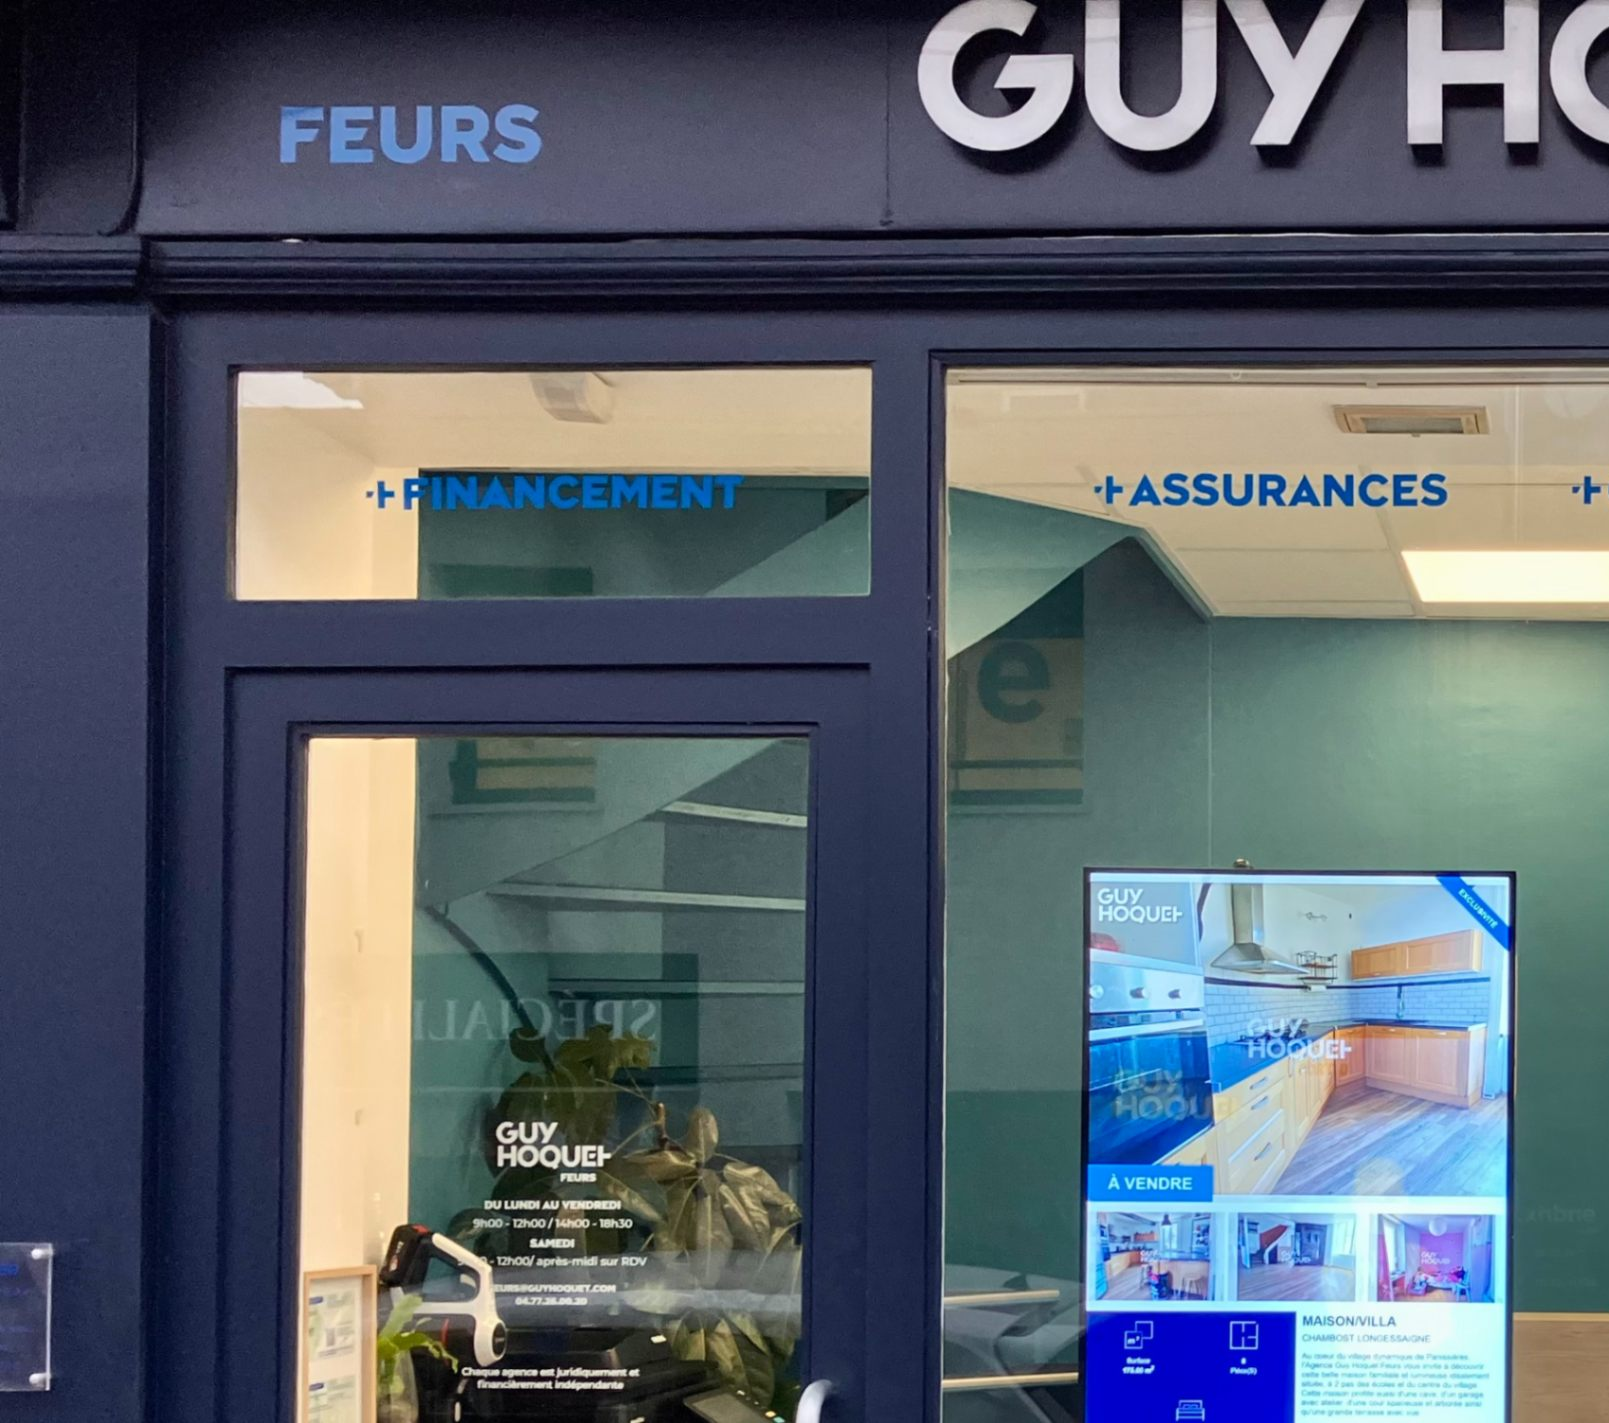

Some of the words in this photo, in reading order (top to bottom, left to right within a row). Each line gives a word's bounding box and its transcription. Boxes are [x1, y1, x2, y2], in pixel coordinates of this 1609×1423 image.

[916, 0, 1365, 152] GUY
[278, 104, 543, 165] FEURS
[1097, 888, 1144, 904] GUY
[1246, 1018, 1305, 1040] GUY
[495, 1121, 559, 1145] GUY
[560, 1173, 597, 1183] FEURS
[1107, 1174, 1120, 1191] À
[1125, 1177, 1193, 1191] VENDRE
[484, 1200, 502, 1210] DU
[504, 1200, 540, 1210] LUNDI
[542, 1200, 559, 1210] AU
[561, 1200, 622, 1210] VENDREDI
[472, 1218, 503, 1229] 9h00
[513, 1218, 546, 1229] 12h00
[555, 1218, 590, 1229] 14h00
[600, 1218, 633, 1229] 18h30
[529, 1238, 575, 1248] SAMEDI
[536, 1256, 598, 1268] après-midi
[600, 1258, 618, 1266] sur
[622, 1256, 648, 1267] RDV
[494, 1284, 617, 1293] EURS@GUYHOQUET.COM
[1302, 1315, 1397, 1327] MAISON/VILLA
[1302, 1334, 1354, 1342] CHAMBOST
[1357, 1334, 1431, 1343] LONGESSAIGNE
[461, 1366, 500, 1377] Chaque
[502, 1368, 538, 1378] agence
[539, 1368, 555, 1377] est
[556, 1366, 628, 1378] juridiquement
[628, 1367, 641, 1377] et
[477, 1379, 553, 1390] financièrement
[554, 1379, 625, 1391] indépendante
